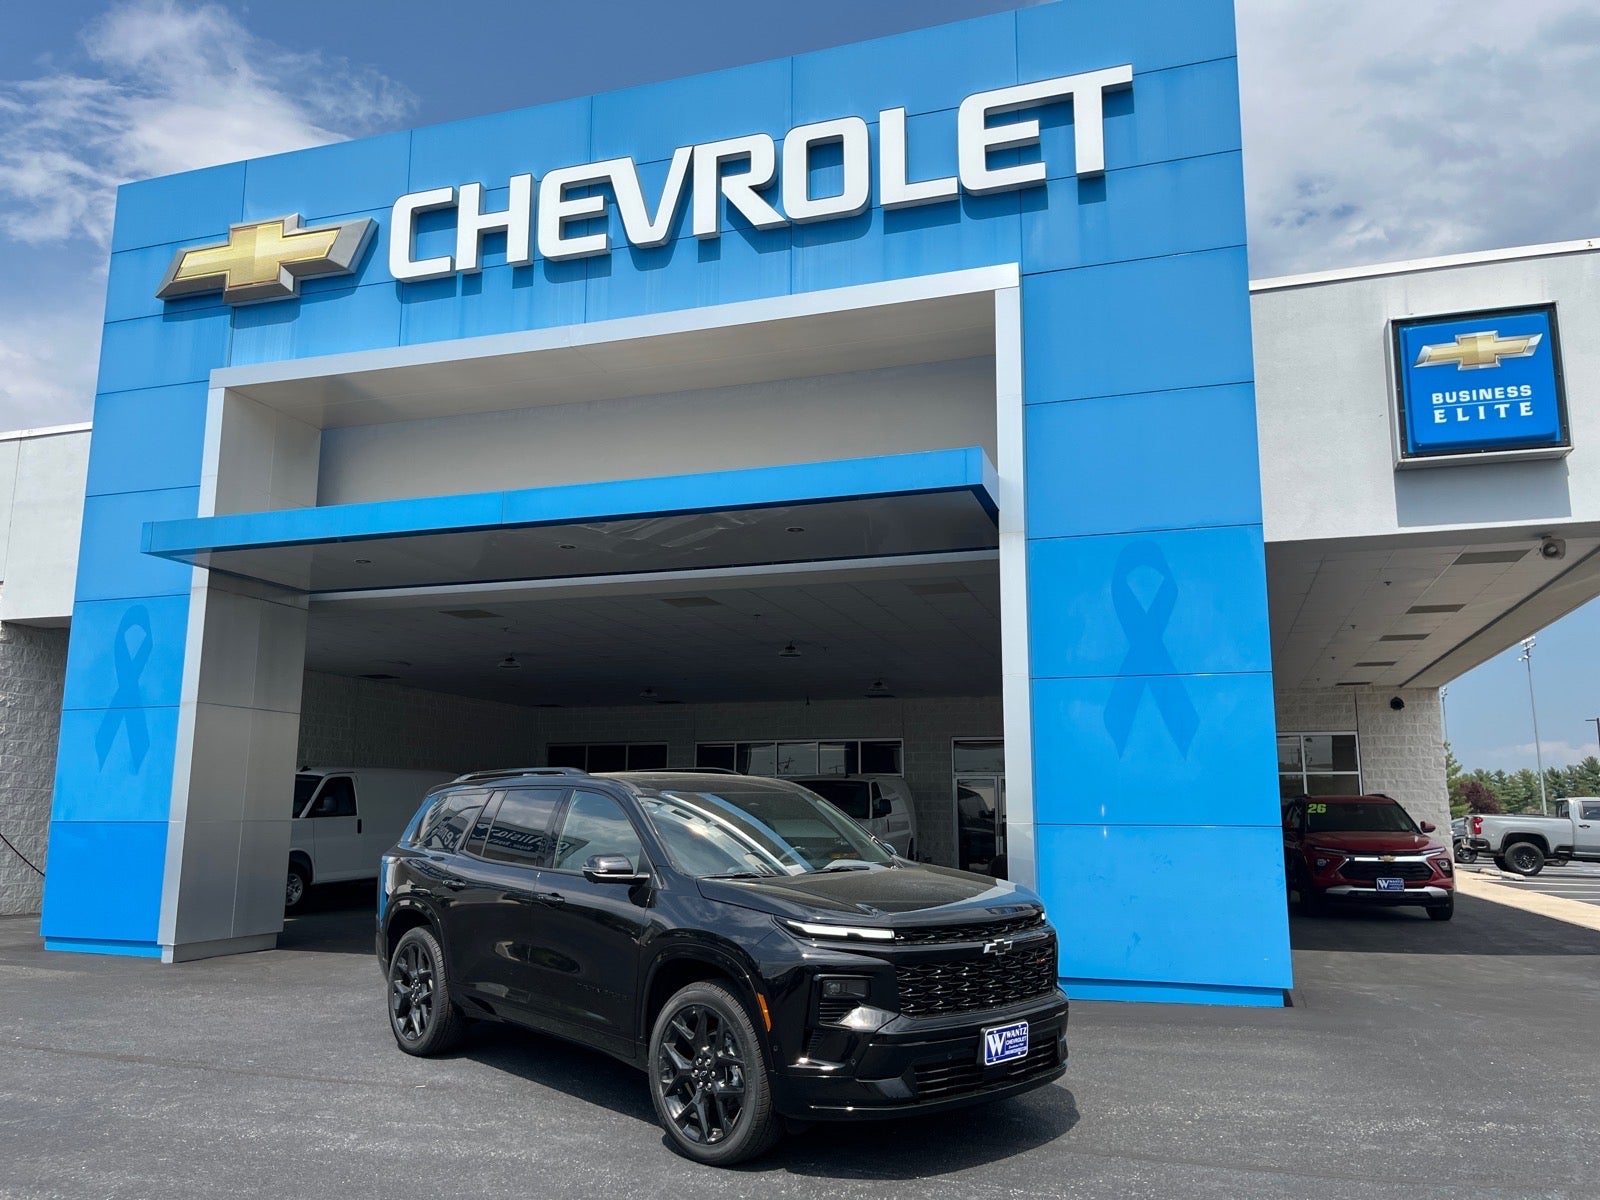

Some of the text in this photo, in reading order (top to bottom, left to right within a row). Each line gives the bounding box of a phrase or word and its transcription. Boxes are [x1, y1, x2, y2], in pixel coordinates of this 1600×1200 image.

[389, 64, 1133, 282] CHEVROLET
[1431, 384, 1532, 404] BUSINESS
[1433, 402, 1533, 424] ELITE
[1307, 803, 1327, 814] 26
[987, 1032, 1006, 1057] W
